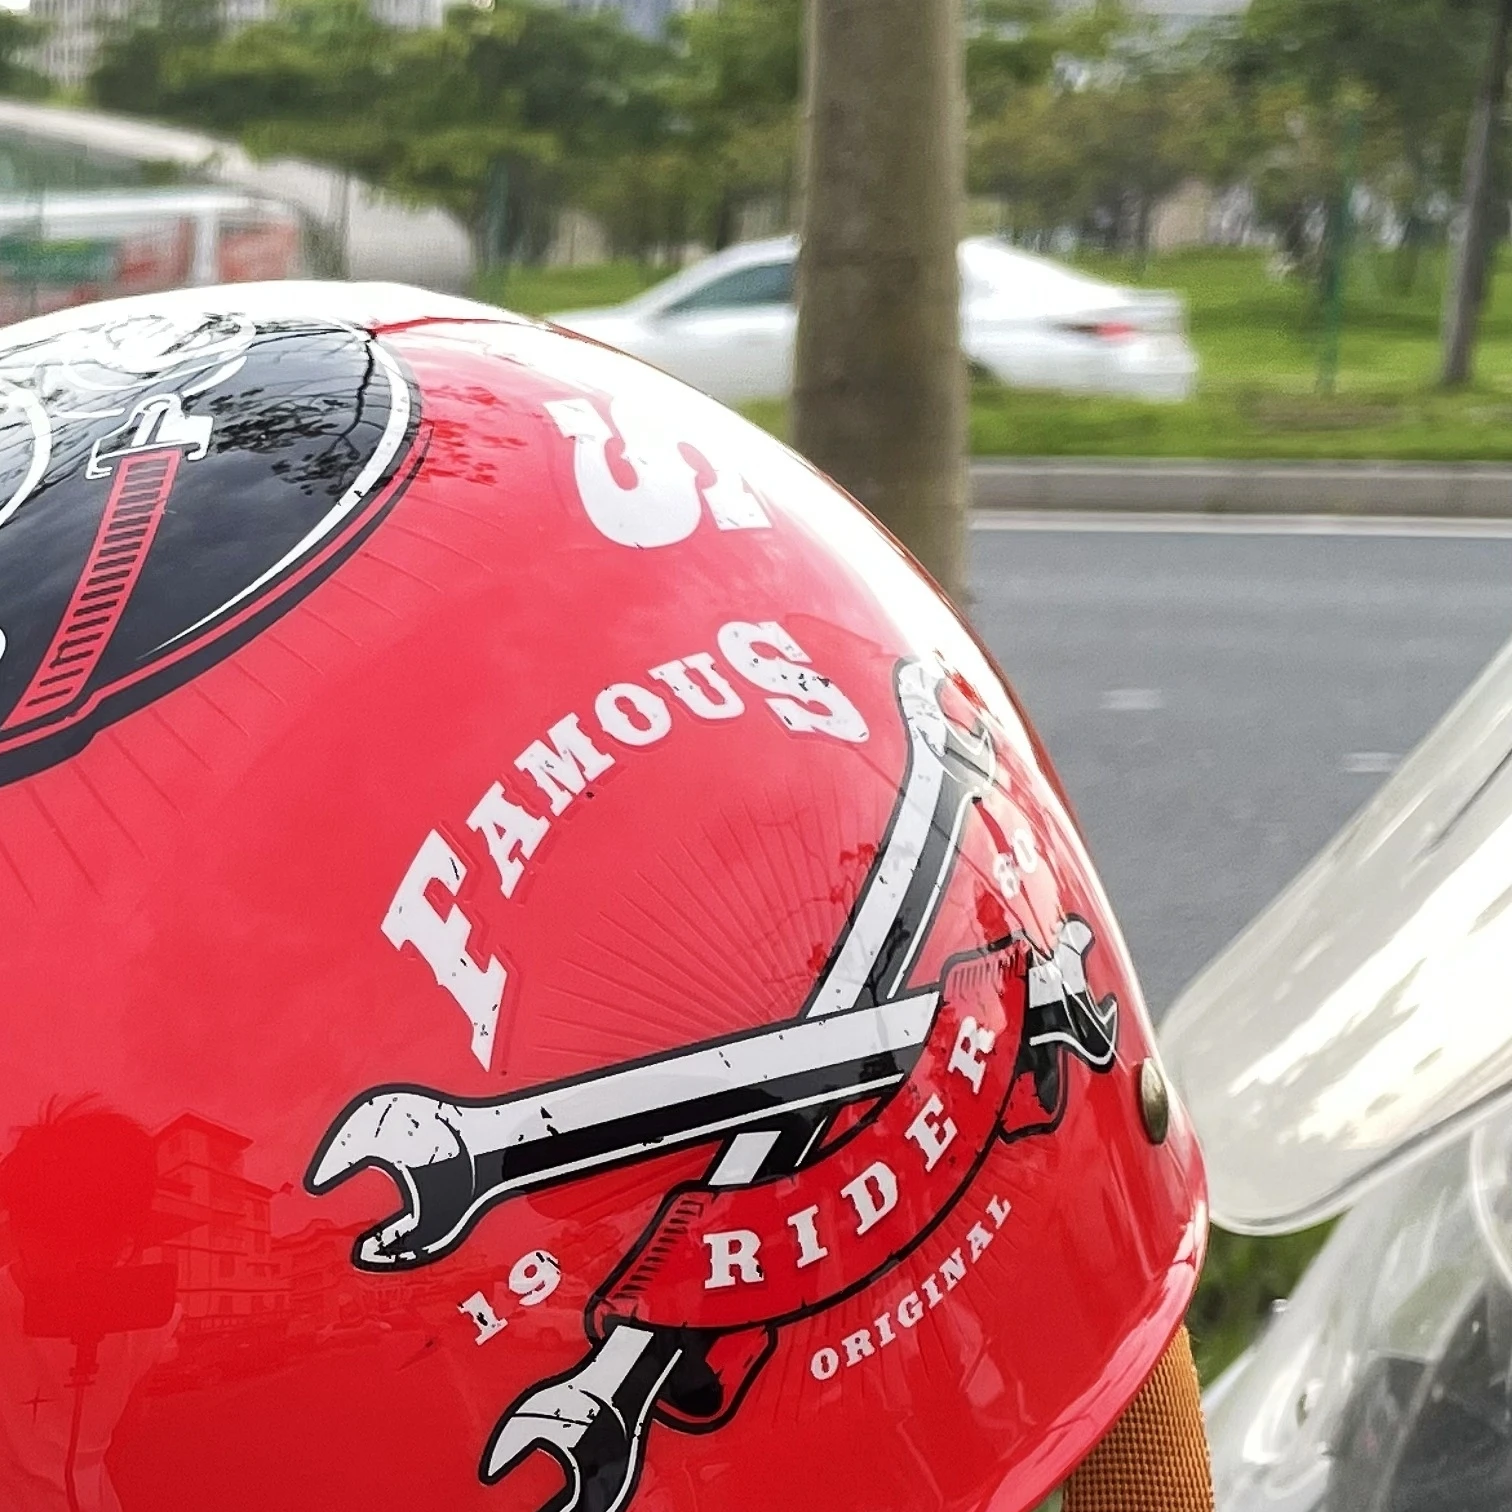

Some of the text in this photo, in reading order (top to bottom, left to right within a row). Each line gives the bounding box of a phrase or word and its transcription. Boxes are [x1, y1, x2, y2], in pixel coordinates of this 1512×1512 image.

[380, 620, 871, 1073] FAMOUS
[703, 1015, 996, 1289] RIDER
[456, 1249, 563, 1346] 19
[810, 1194, 1013, 1381] ORIGINAL
